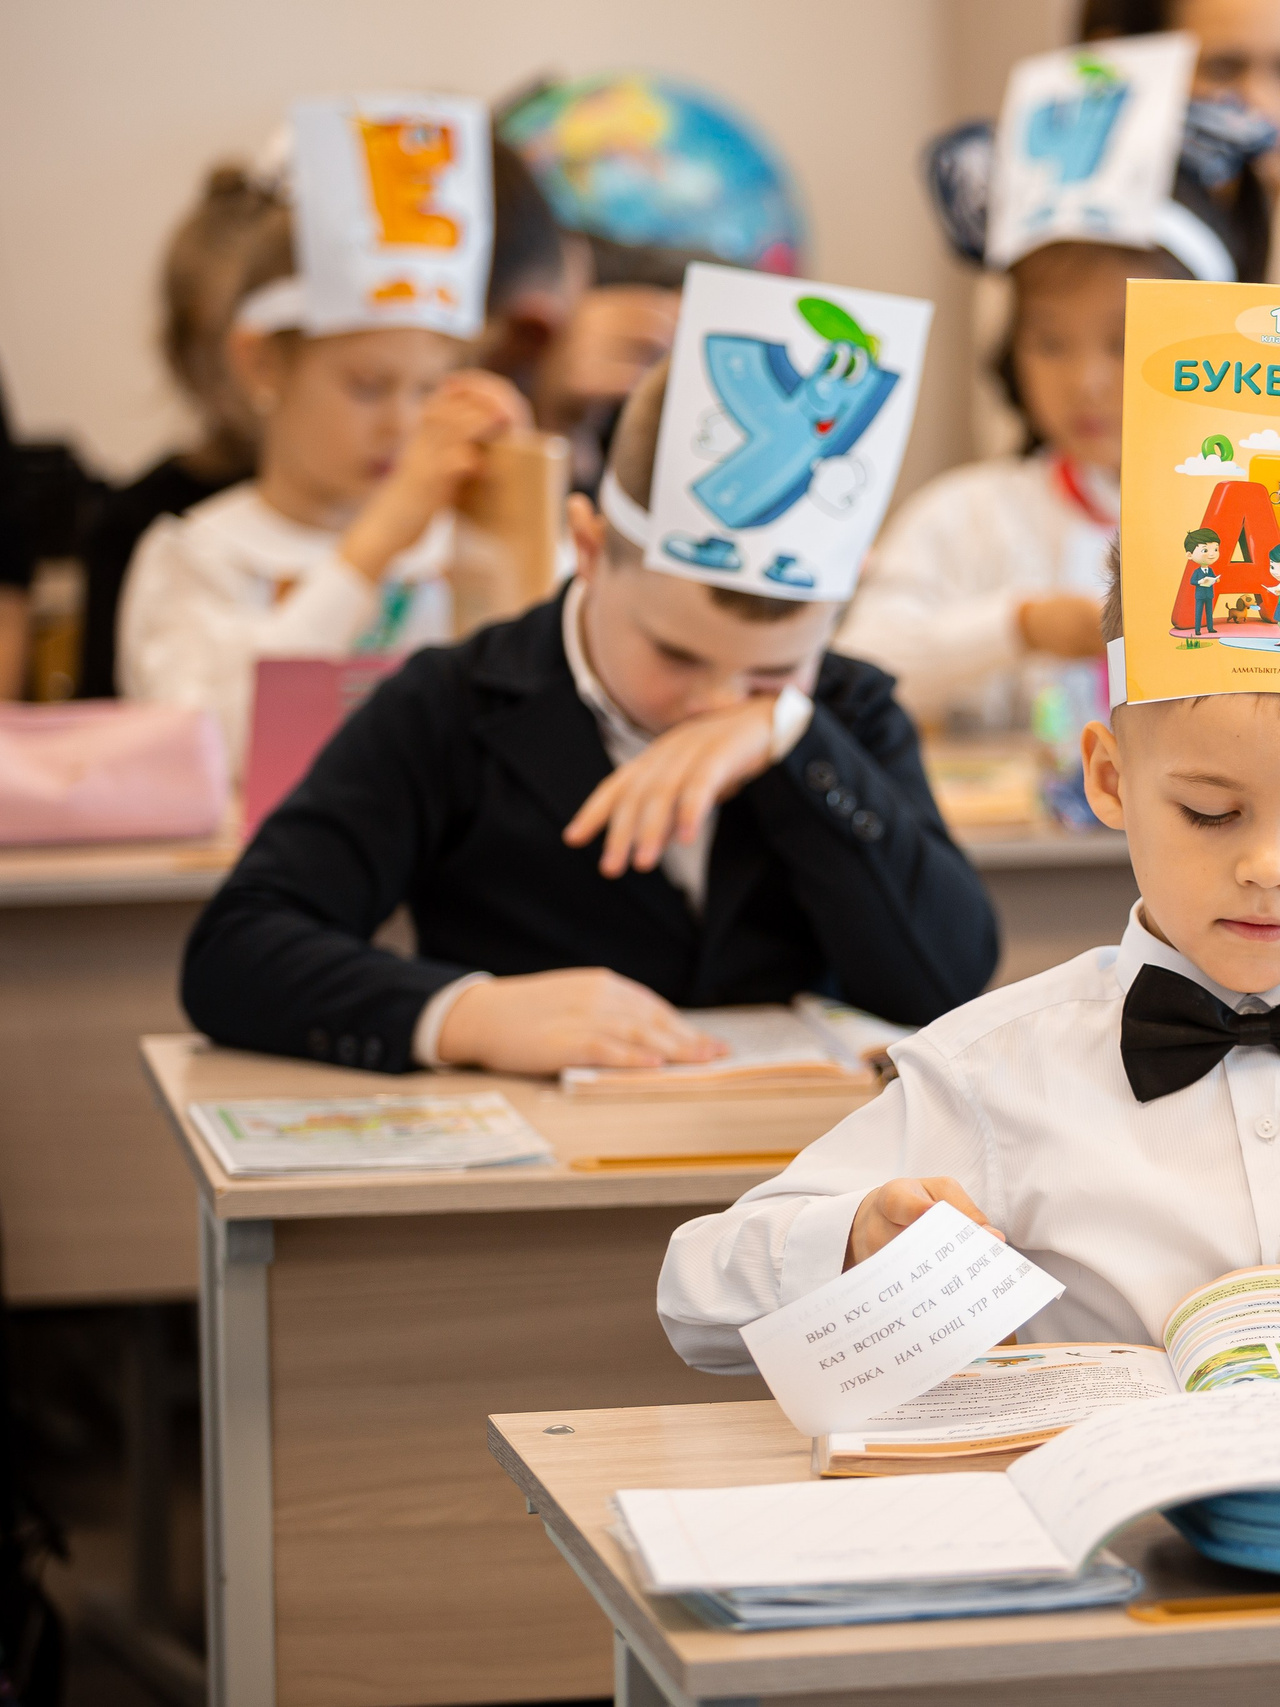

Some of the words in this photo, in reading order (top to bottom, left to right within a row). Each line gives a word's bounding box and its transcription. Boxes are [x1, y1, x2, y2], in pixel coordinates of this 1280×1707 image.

[805, 1322, 837, 1344] ВЬЮ
[844, 1301, 872, 1323] КУС
[878, 1281, 904, 1303] СТИ
[910, 1260, 933, 1282] АЛК
[935, 1242, 955, 1262] ПРО
[818, 1351, 846, 1371] КАЗ
[852, 1317, 906, 1354] ВСПОРХ
[911, 1298, 937, 1319] СТА
[941, 1274, 964, 1297] ЧЕЙ
[966, 1254, 991, 1280] ДОЧК
[840, 1366, 885, 1393] ЛУБКА
[894, 1343, 923, 1366] НАЧ
[928, 1316, 965, 1345] КОНЦ
[967, 1297, 988, 1317] УТР
[992, 1274, 1017, 1299] РЫБК
